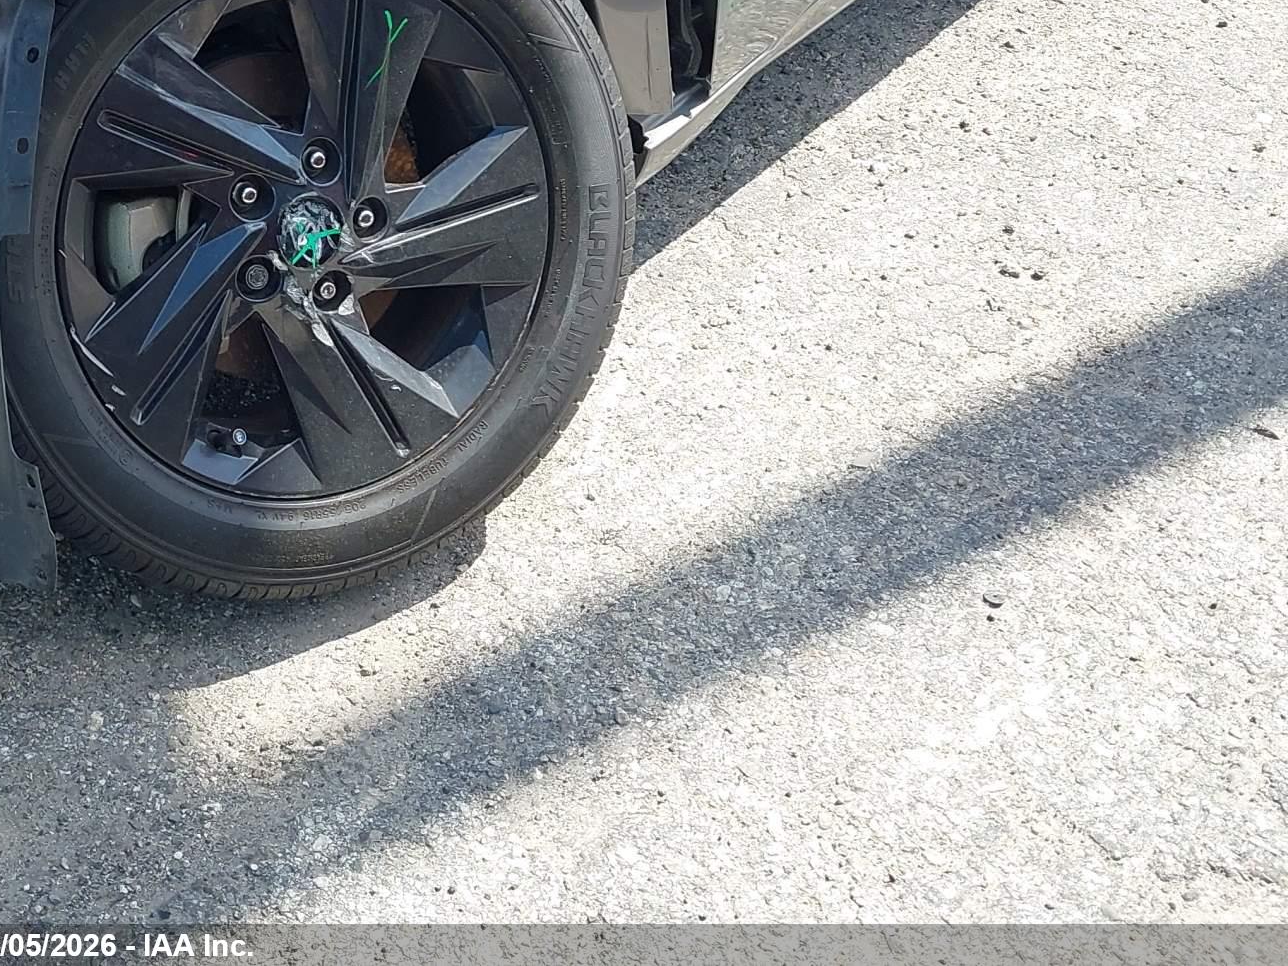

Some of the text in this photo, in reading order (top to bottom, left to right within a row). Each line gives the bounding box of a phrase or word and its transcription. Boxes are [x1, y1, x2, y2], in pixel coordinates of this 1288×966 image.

[530, 183, 611, 419] BLACKHAWK
[397, 419, 489, 494] RADIAL TUBELESS
